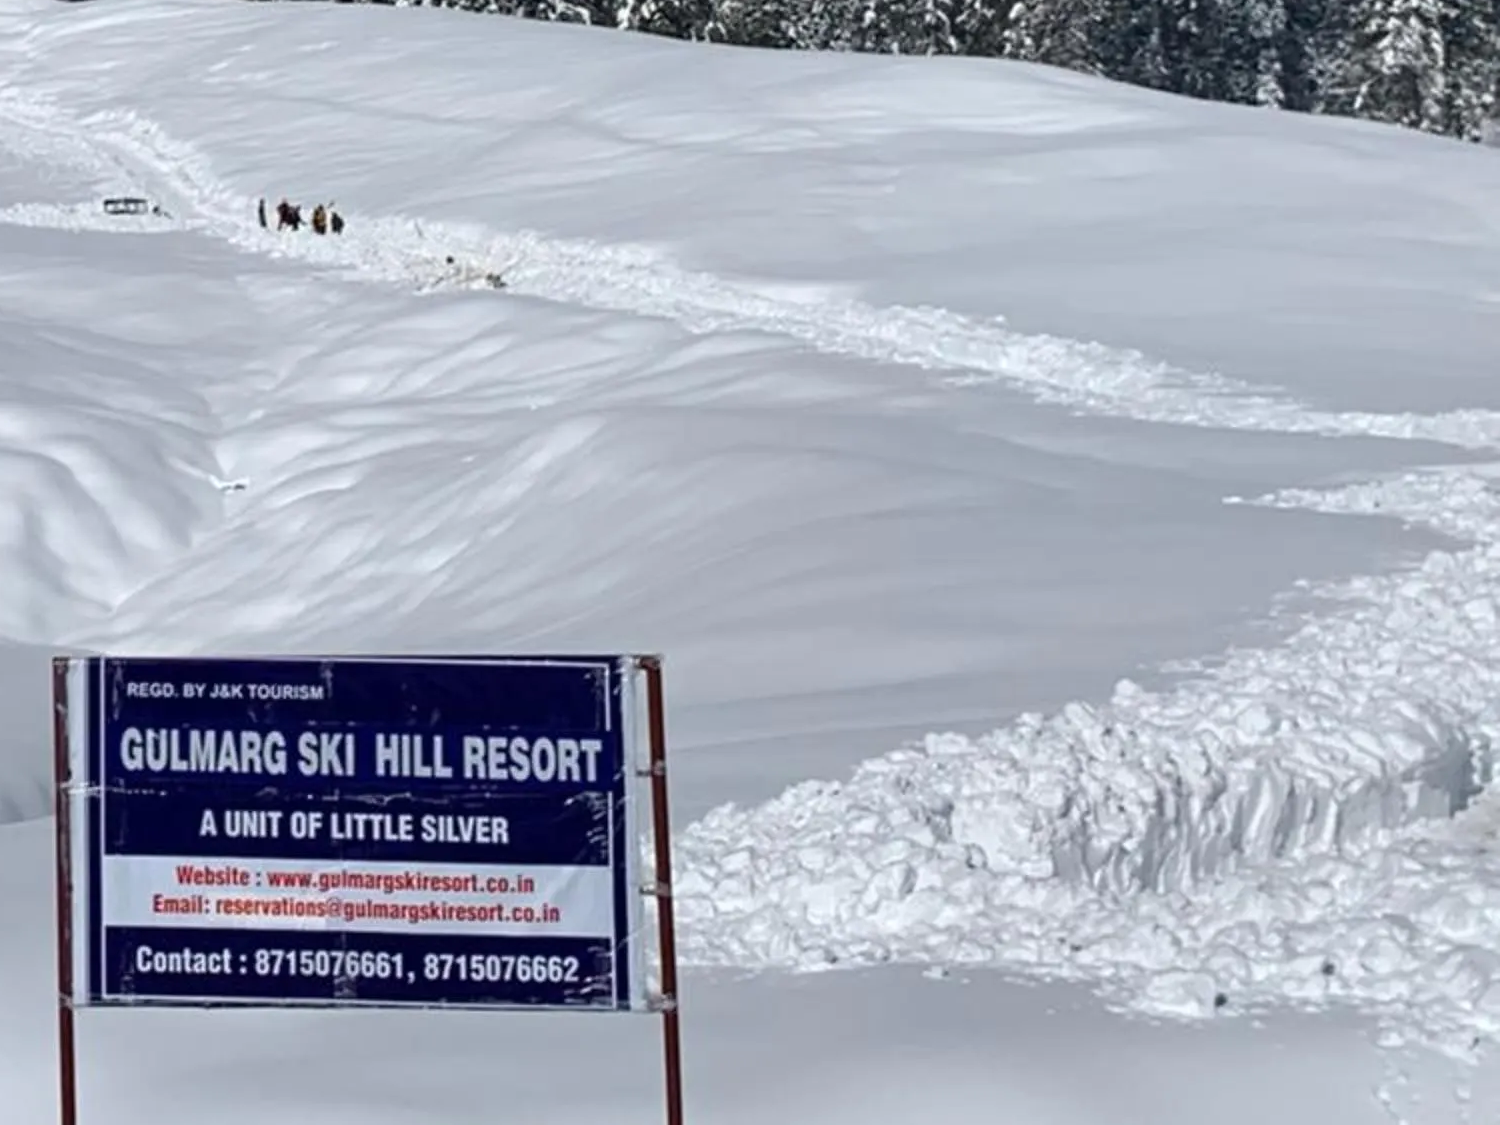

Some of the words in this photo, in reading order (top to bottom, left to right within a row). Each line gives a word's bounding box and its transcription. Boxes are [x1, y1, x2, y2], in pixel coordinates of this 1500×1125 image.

[127, 682, 179, 698] REGD.
[183, 683, 205, 698] BY
[209, 684, 244, 699] J&K
[247, 684, 324, 700] TOURISM
[120, 727, 287, 775] GULMARG
[297, 732, 356, 777] SKI
[375, 733, 452, 779] HILL
[463, 736, 602, 783] RESORT
[199, 811, 217, 836] A
[224, 811, 281, 838] UNIT
[289, 812, 322, 839] OF
[330, 813, 413, 842] LITTLE
[421, 815, 509, 844] SILVER
[176, 865, 250, 886] Website
[267, 869, 535, 894] www.gulmargskiresort.co.in
[152, 894, 211, 915] Email:
[215, 896, 561, 924] reservations@gulmargskiresort.co.in
[136, 946, 233, 973] Contact
[423, 953, 579, 982] 8715076662
